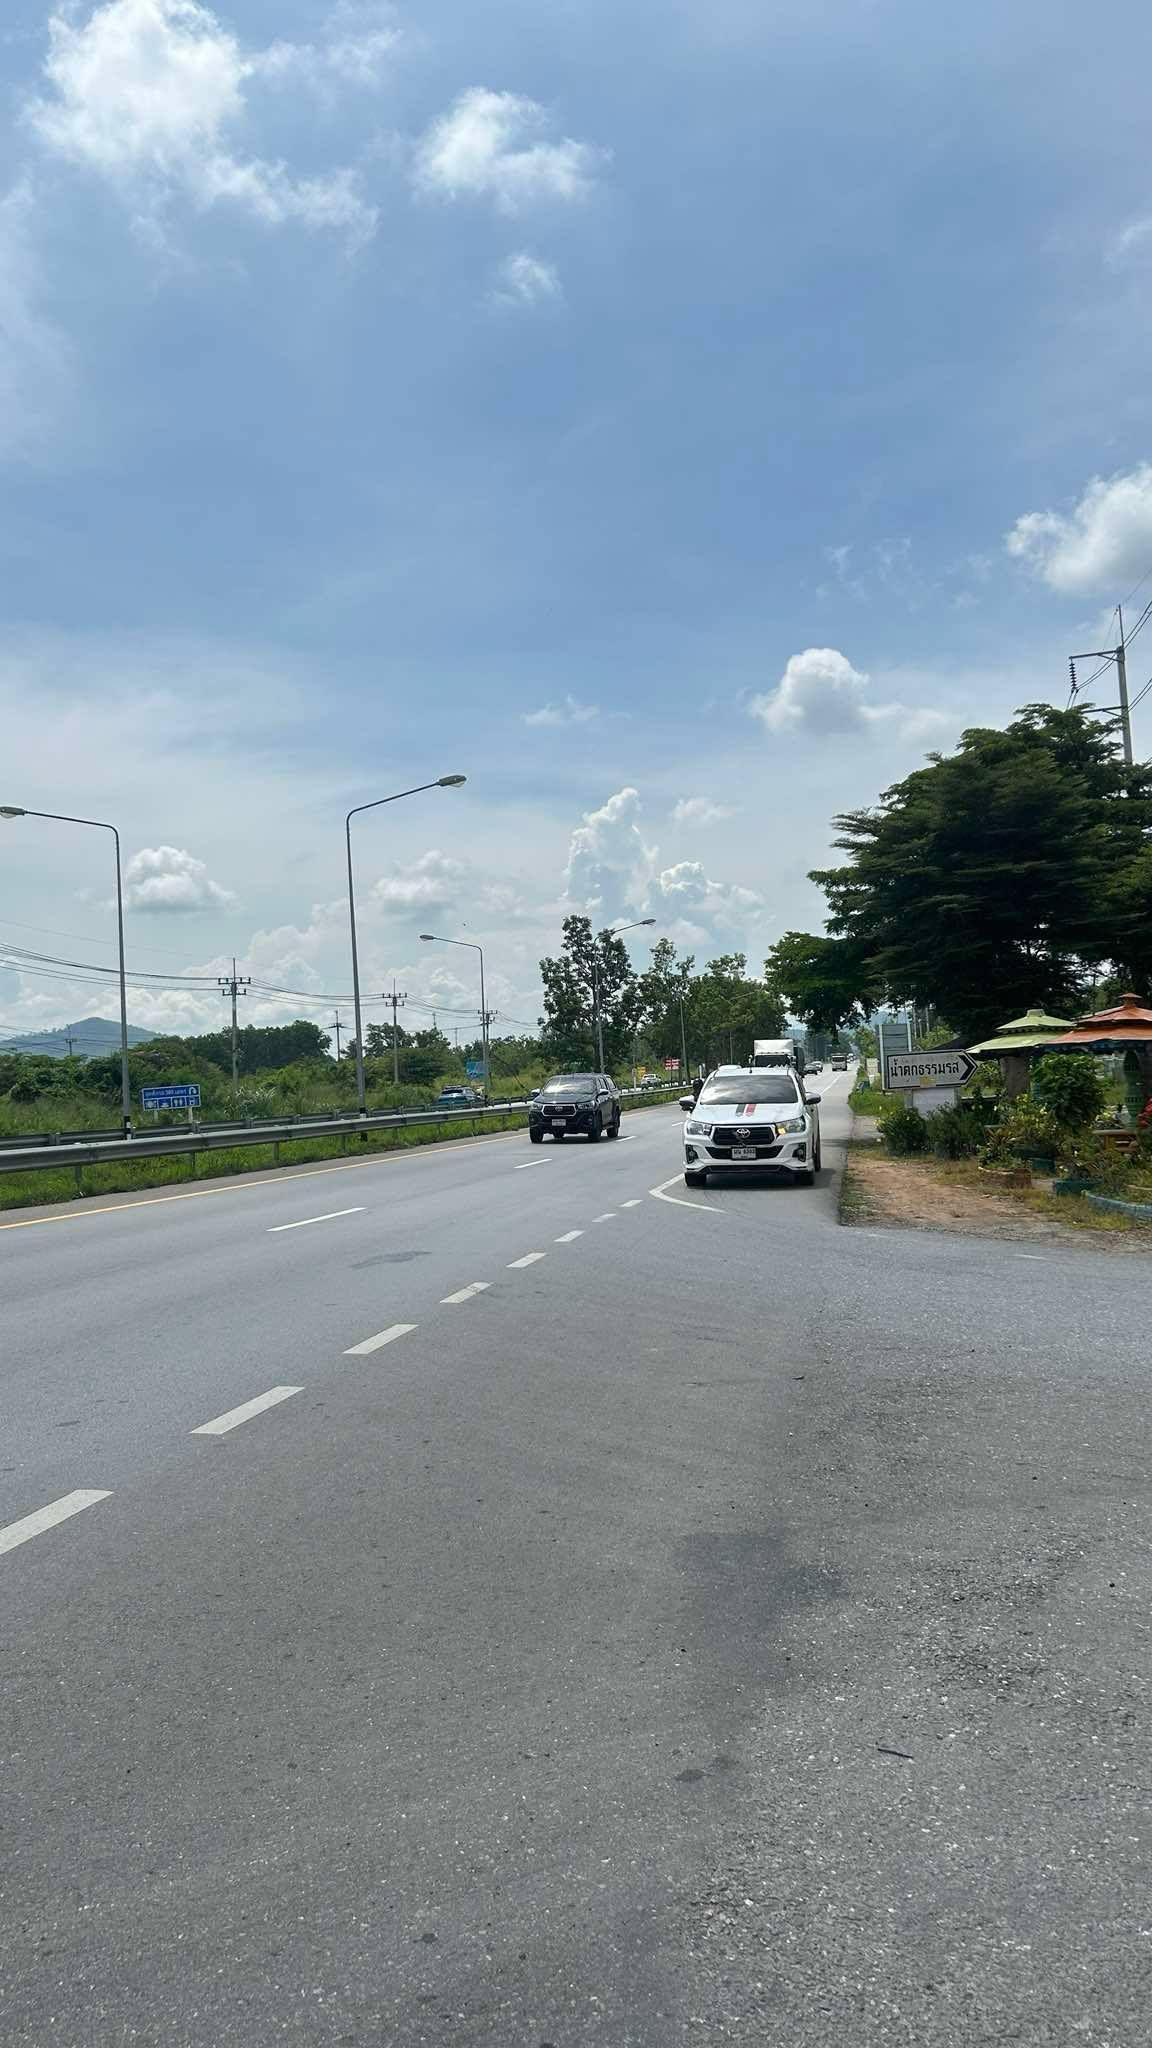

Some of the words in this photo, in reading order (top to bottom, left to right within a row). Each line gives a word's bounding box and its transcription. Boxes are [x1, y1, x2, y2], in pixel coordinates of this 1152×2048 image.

[890, 1058, 960, 1077] น้ำตกธรรมรส
